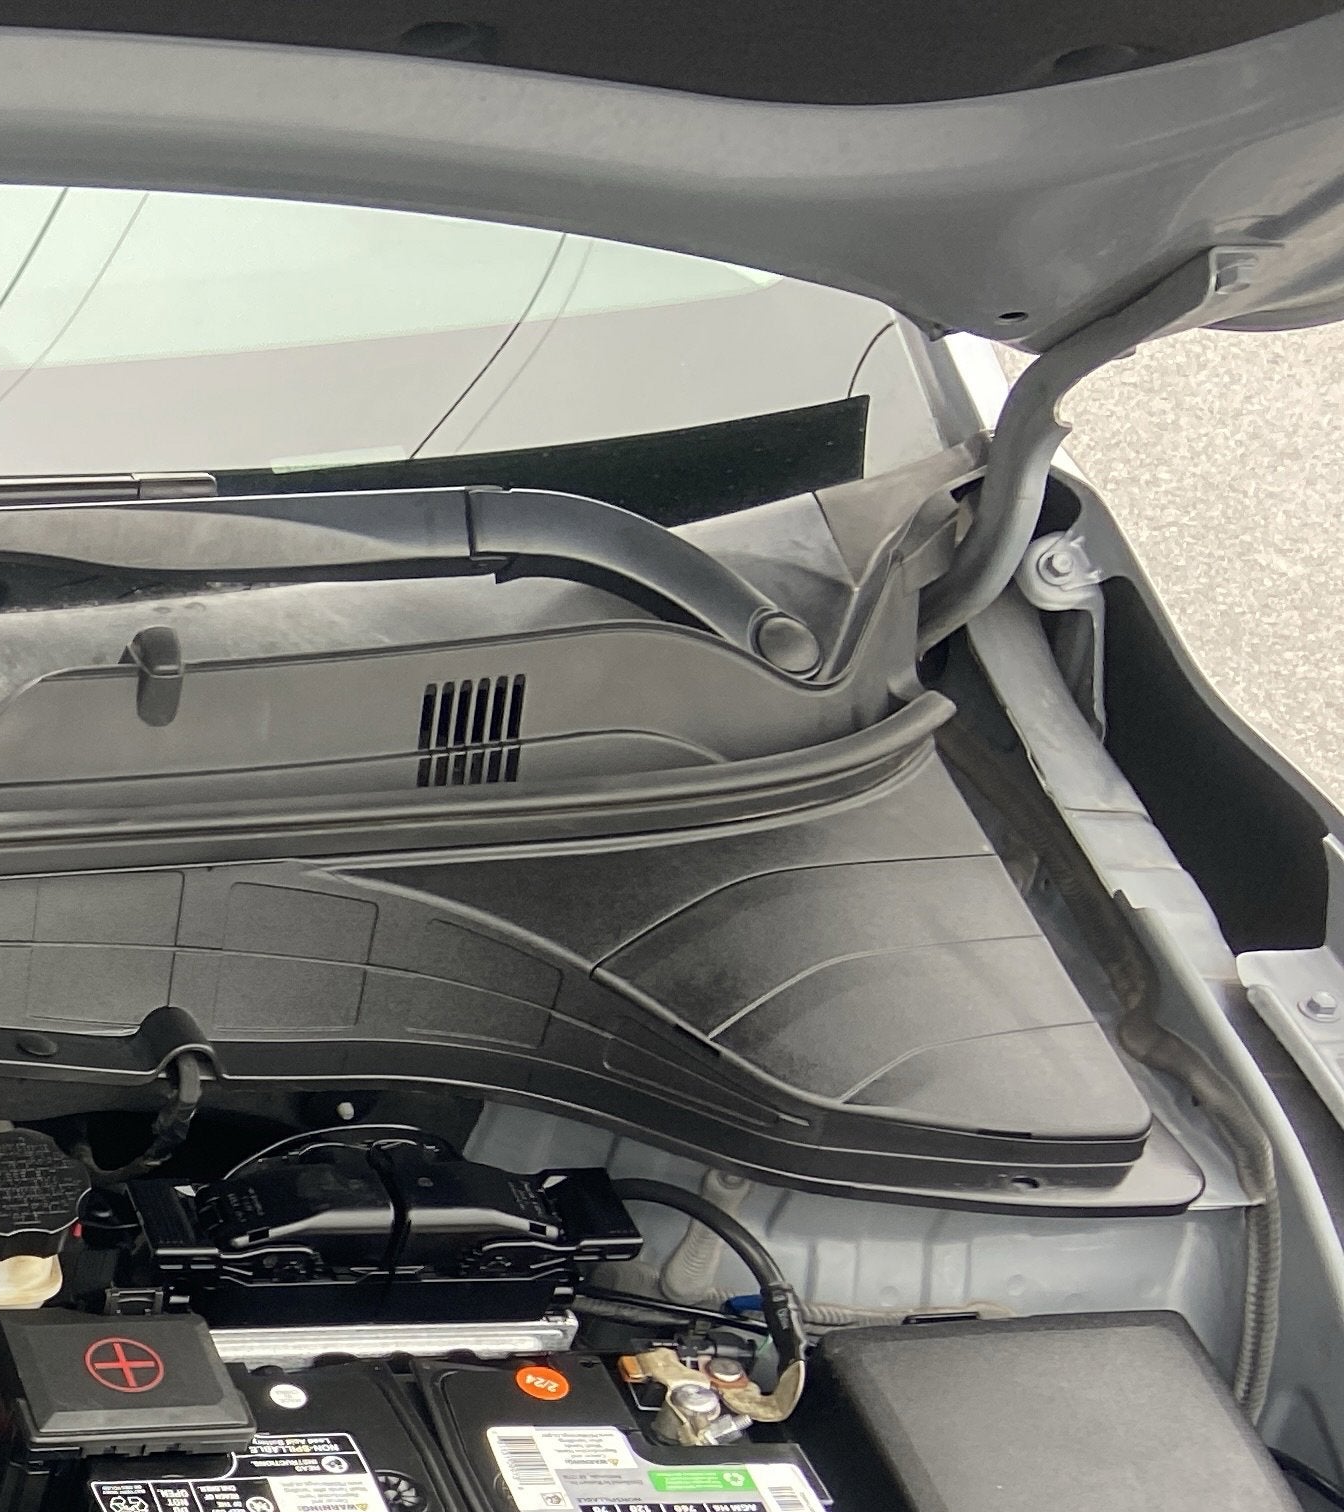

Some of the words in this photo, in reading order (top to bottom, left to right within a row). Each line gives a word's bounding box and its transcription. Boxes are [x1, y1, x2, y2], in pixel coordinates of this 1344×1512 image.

[525, 1374, 560, 1393] 2/24
[165, 1498, 190, 1508] NOT
[728, 1503, 758, 1512] AGM
